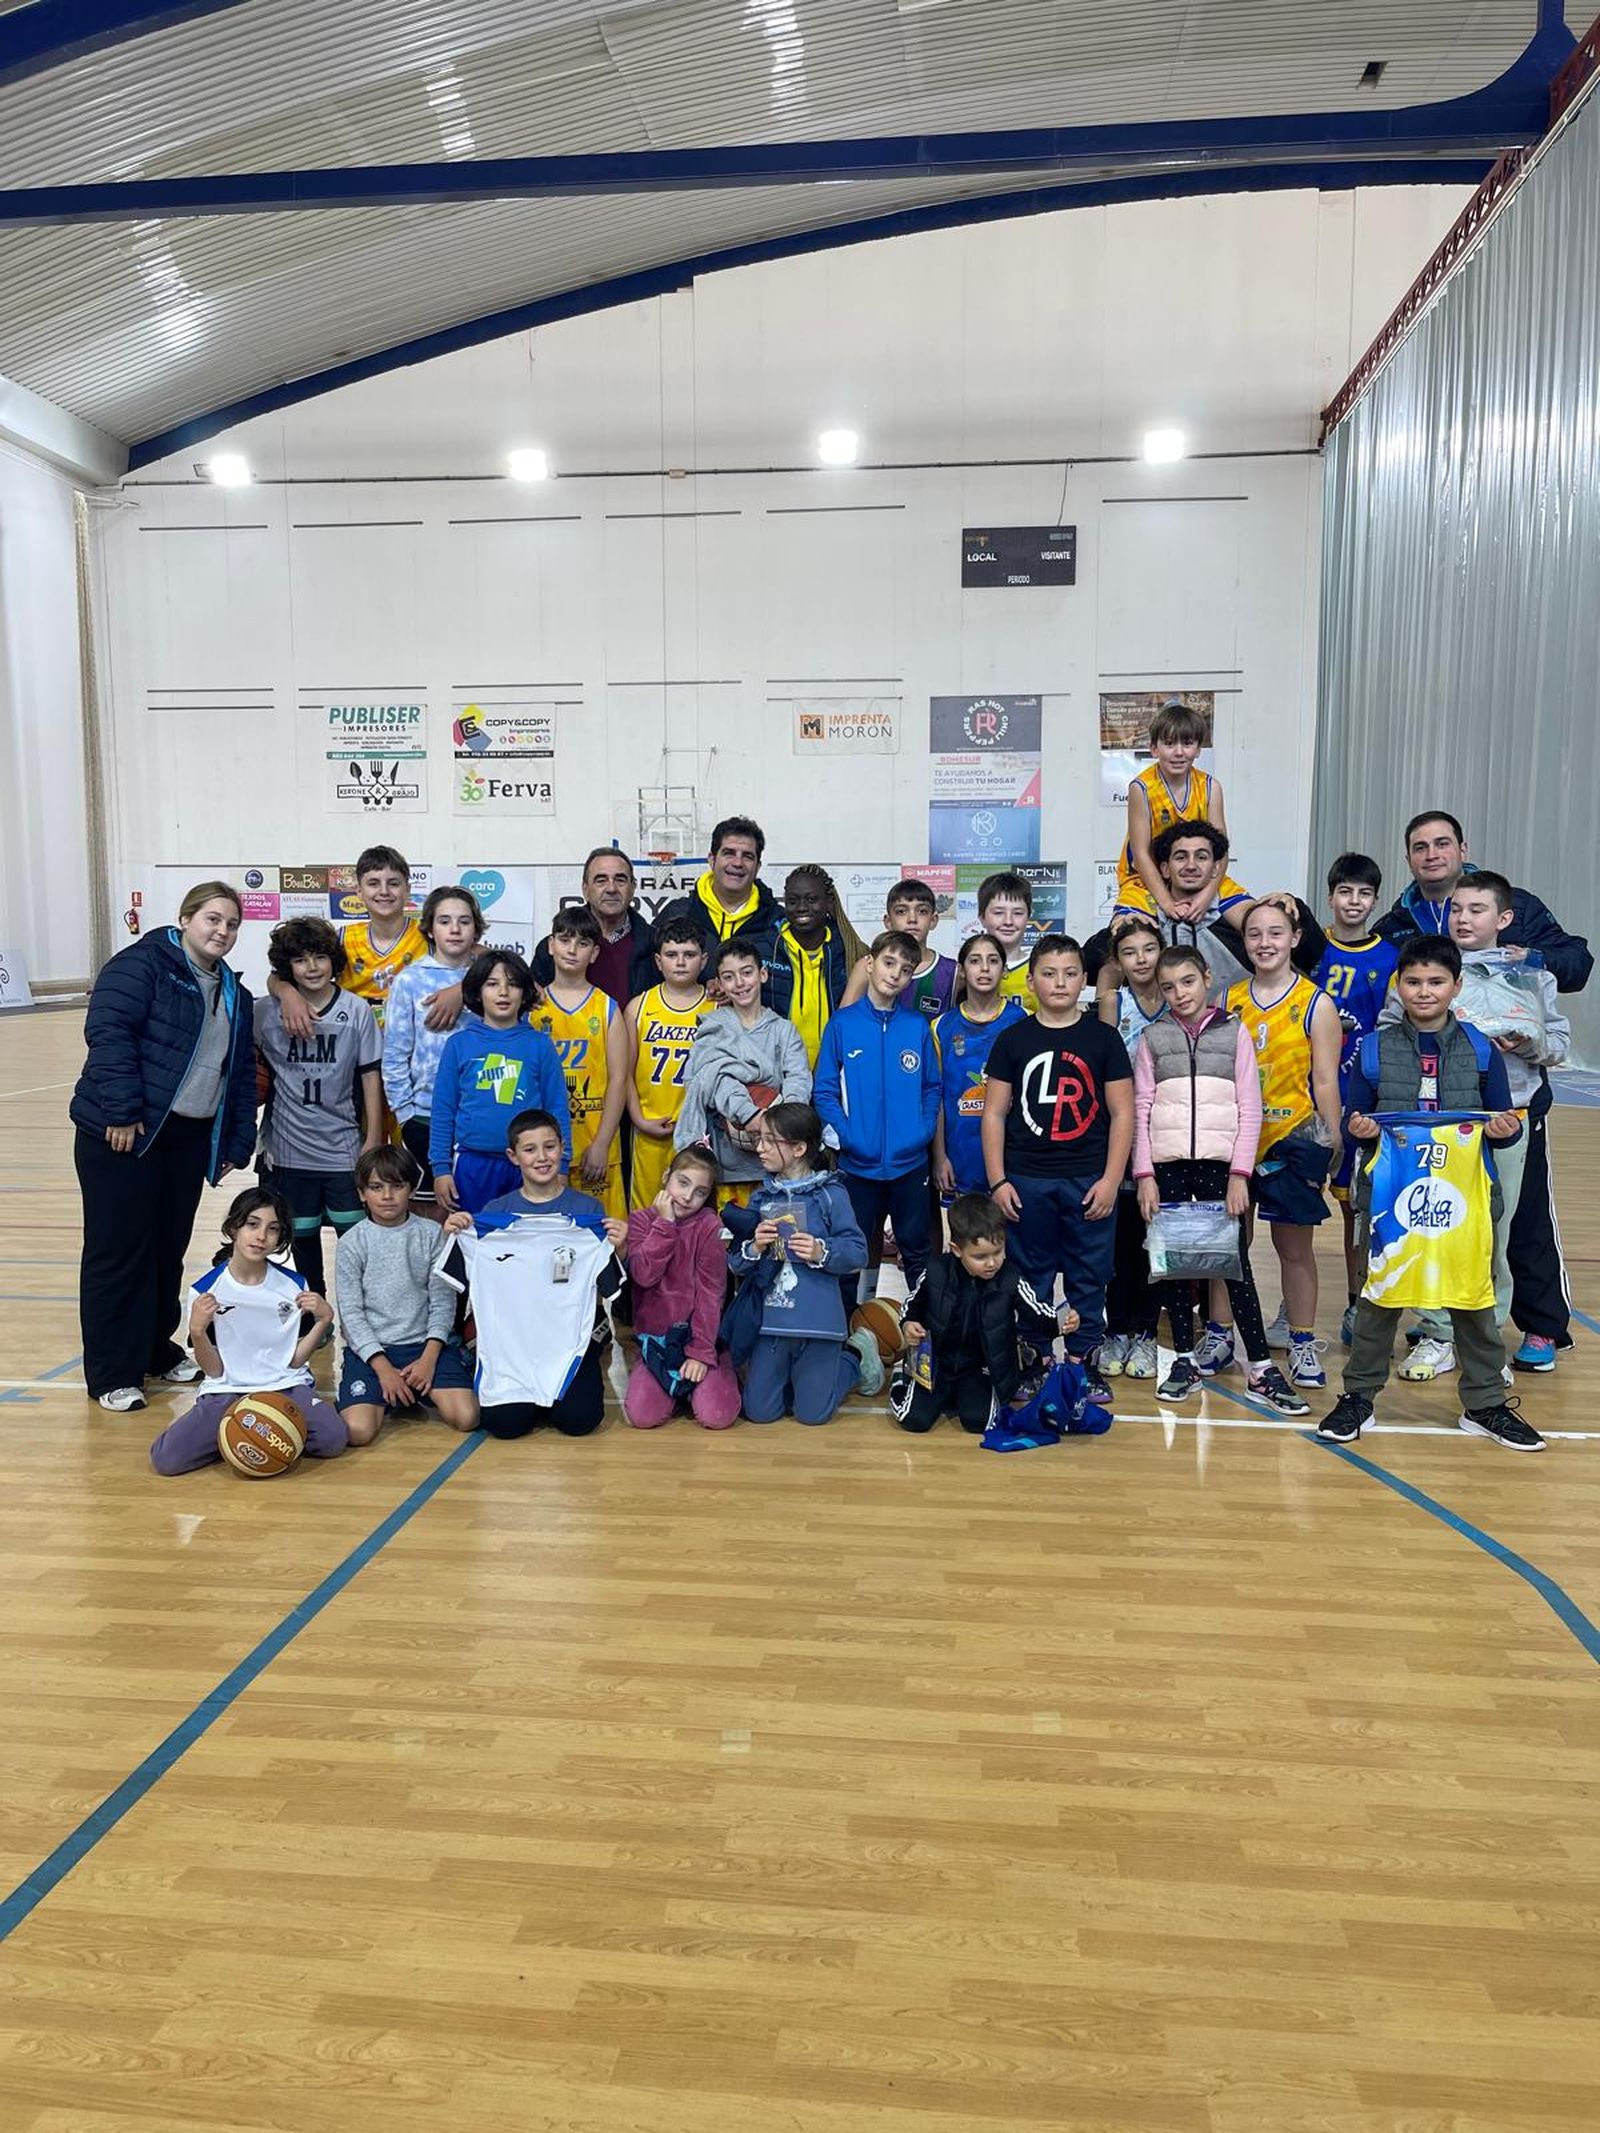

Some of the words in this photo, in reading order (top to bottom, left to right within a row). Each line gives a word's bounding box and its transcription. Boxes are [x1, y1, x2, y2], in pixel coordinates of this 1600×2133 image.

[967, 552, 998, 562] LOCAL
[1041, 551, 1071, 560] VISITANTE
[1007, 575, 1030, 584] PERIODO
[329, 706, 421, 724] PUBLISER
[987, 700, 1006, 713] HOT
[343, 724, 407, 732] IMPRESORES
[485, 718, 551, 727] COPY&COPY
[829, 714, 892, 725] IMPRENTA
[963, 716, 995, 746] PEPPERS
[488, 779, 552, 798] Ferva
[916, 868, 953, 876] MAPFRE
[468, 882, 496, 891] cara
[1325, 963, 1357, 999] 27
[642, 1020, 698, 1043] LAKER
[1256, 1023, 1269, 1050] 3
[286, 1033, 337, 1064] ALM
[651, 1046, 690, 1085] 77
[302, 1078, 323, 1106] 11
[1415, 1143, 1449, 1169] 79
